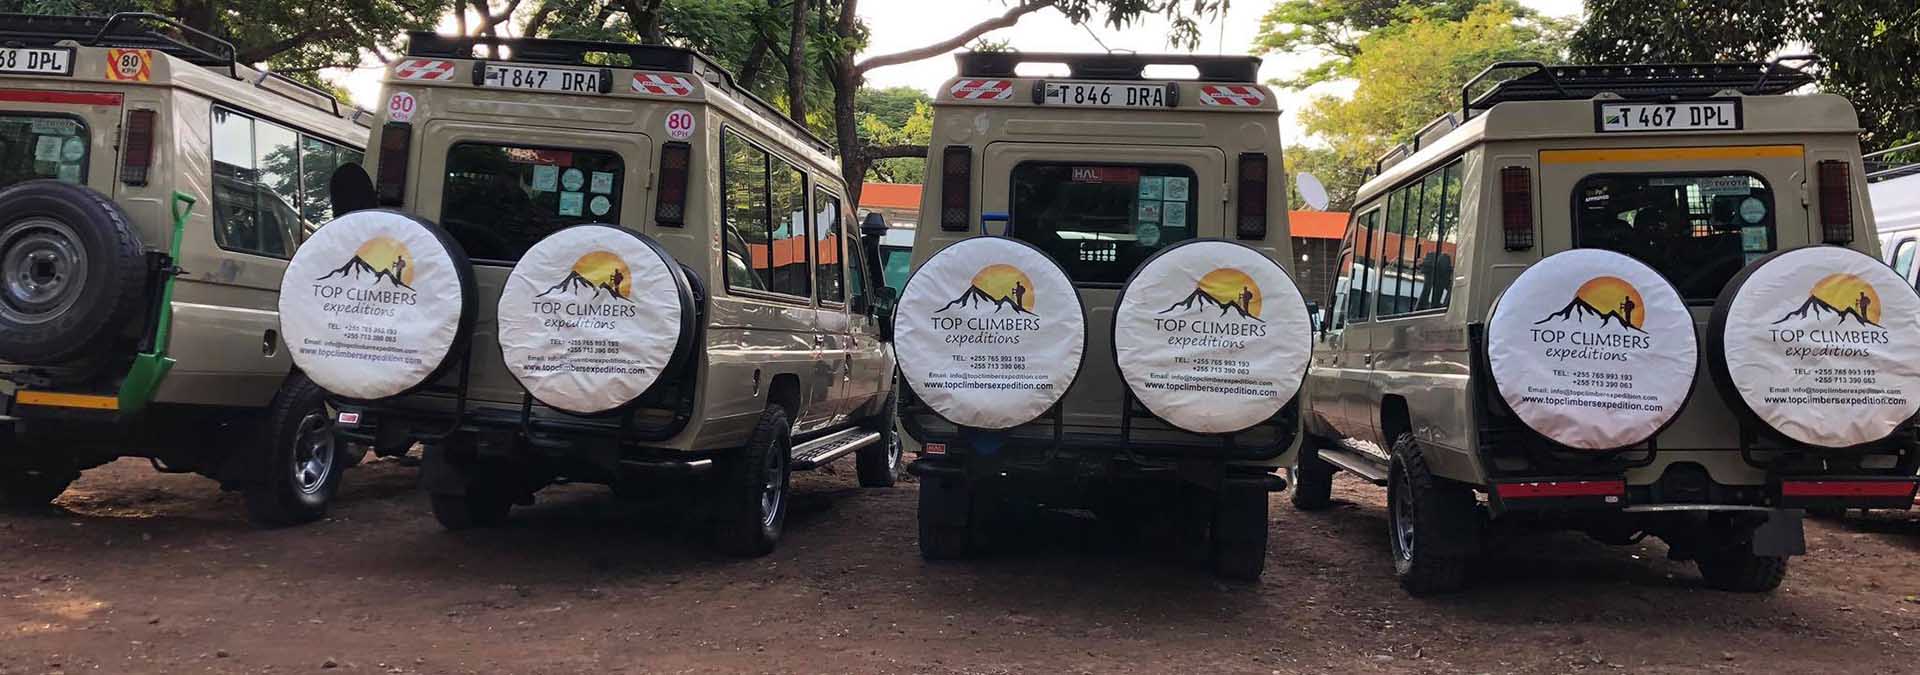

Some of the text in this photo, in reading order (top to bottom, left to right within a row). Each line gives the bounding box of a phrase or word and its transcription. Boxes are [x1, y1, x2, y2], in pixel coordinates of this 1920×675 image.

[28, 51, 62, 70] DPL
[122, 54, 138, 67] 80
[499, 71, 597, 92] T 847 DRA
[1059, 86, 1164, 106] T 846 DRA
[391, 96, 413, 112] 80
[668, 114, 692, 130] 80
[1619, 106, 1729, 127] T 467 DPL
[1074, 168, 1098, 178] HAL
[312, 284, 416, 305] TOP CLIMBERS
[324, 302, 395, 317] expeditions
[532, 302, 636, 318] TOP CLIMBERS
[544, 317, 615, 331] expeditions
[931, 317, 1040, 331] TOP CLIMBERS
[1154, 318, 1266, 336] TOP CLIMBERS
[945, 332, 1020, 346] expeditions
[1168, 335, 1245, 350] expeditions
[1530, 330, 1650, 349] TOP CLIMBERS
[1769, 330, 1888, 344] TOP CLIMBERS
[1546, 347, 1627, 362] expeditions
[1786, 345, 1870, 360] expeditions
[924, 381, 1054, 391] www.topclimbersexpedition.com
[1145, 382, 1277, 397] www.topclimbersexpedition.com
[1522, 396, 1662, 412] www.topclimbersexpedition.com
[1764, 396, 1906, 406] www.topclimbersexpedition.com
